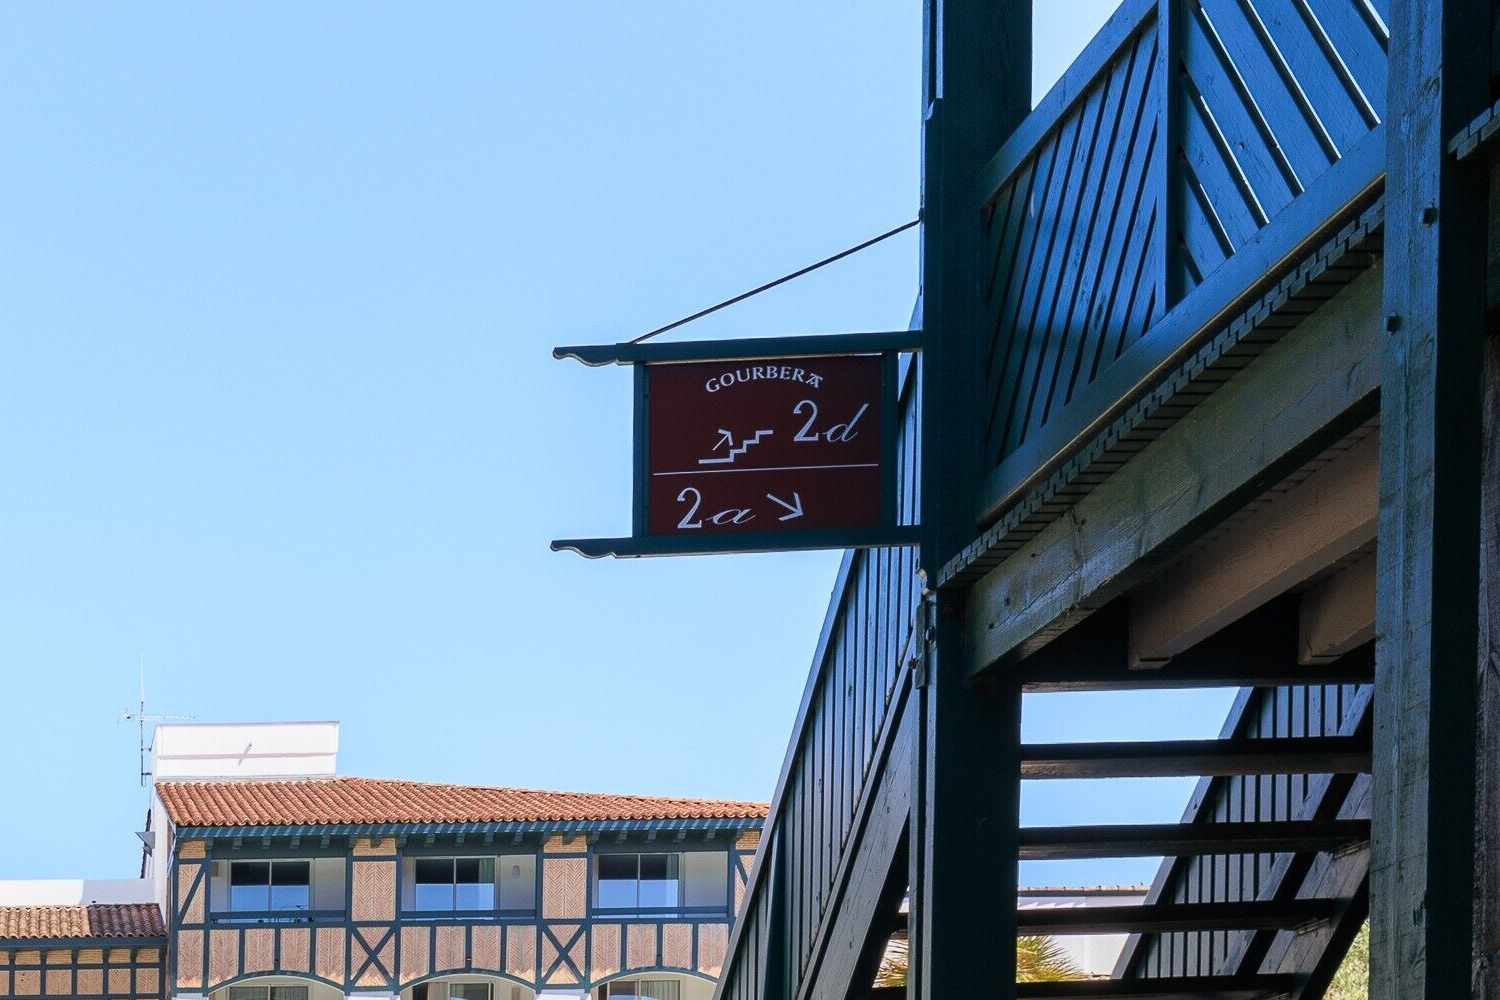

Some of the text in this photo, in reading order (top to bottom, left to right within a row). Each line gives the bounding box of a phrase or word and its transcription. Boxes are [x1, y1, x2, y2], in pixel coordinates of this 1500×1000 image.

[705, 365, 823, 393] GOURBERA
[793, 400, 869, 443] 2d
[676, 487, 756, 529] 2a
